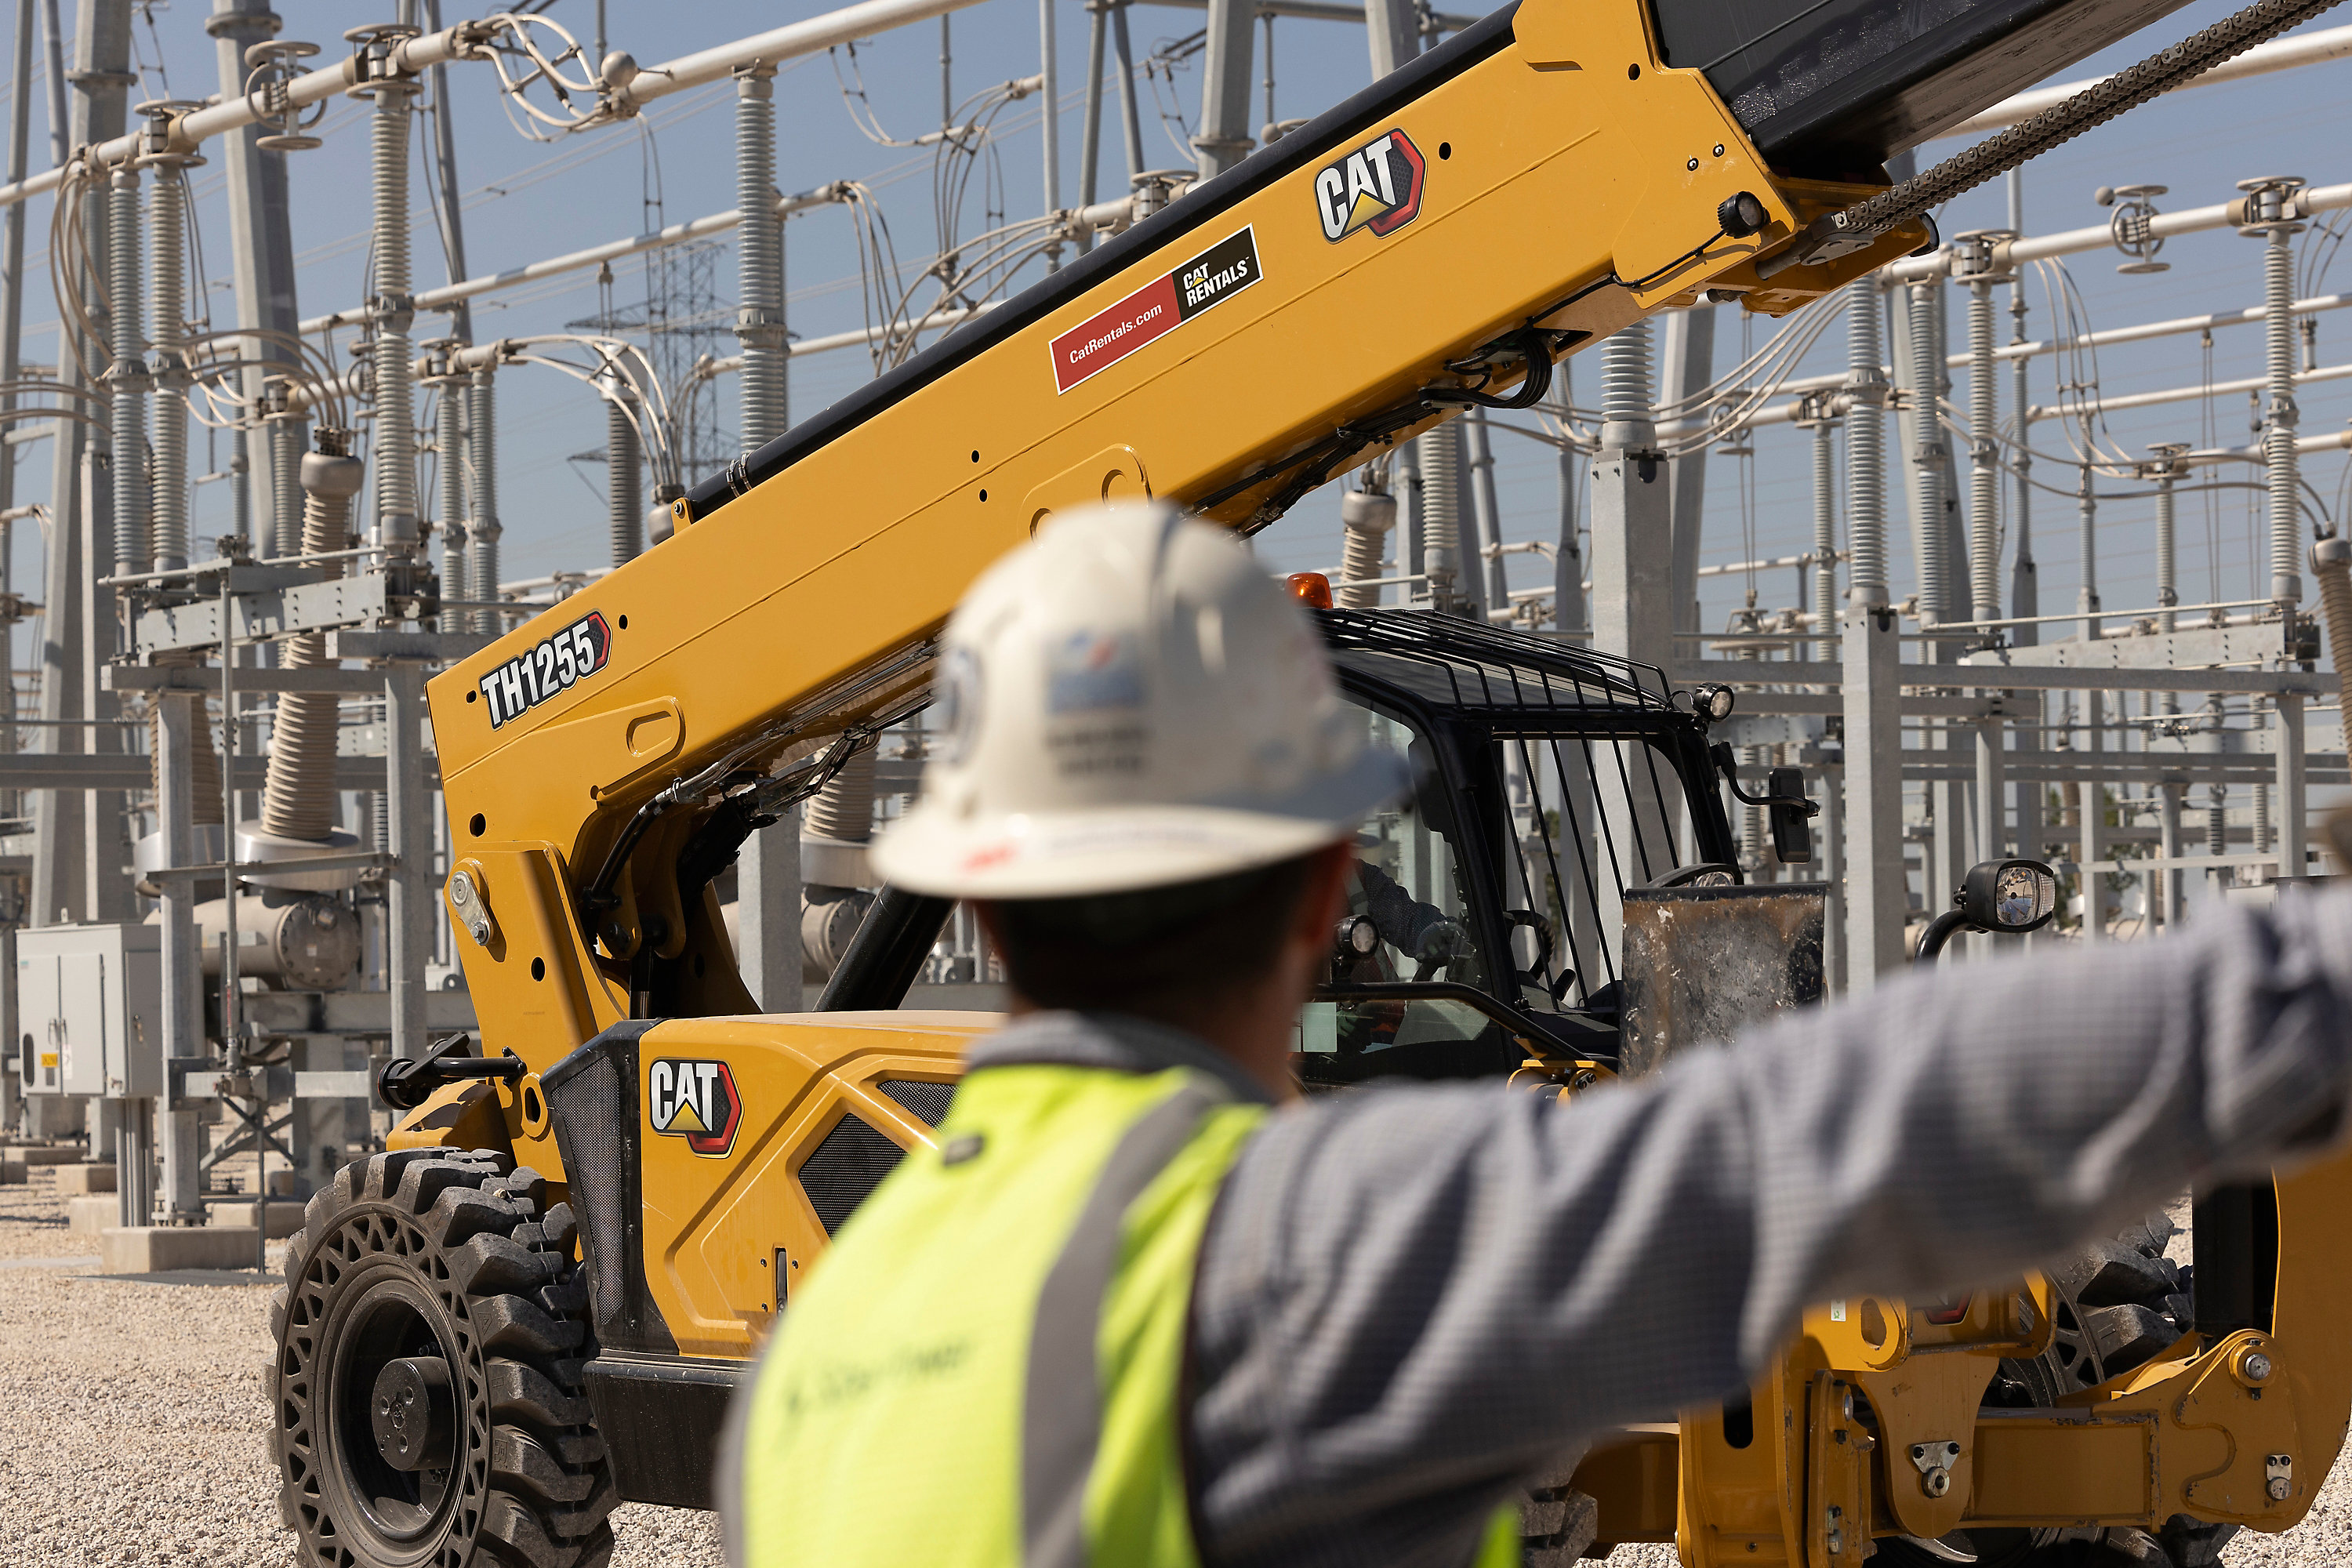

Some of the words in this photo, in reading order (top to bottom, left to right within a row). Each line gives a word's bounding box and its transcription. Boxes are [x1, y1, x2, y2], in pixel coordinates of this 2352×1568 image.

[1316, 135, 1396, 238] CAT
[1183, 262, 1209, 290] CAT
[1185, 260, 1249, 308] RENTALS
[1069, 304, 1163, 364] CatRentals.com
[481, 619, 595, 726] TH1255
[651, 1061, 718, 1131] CAT
